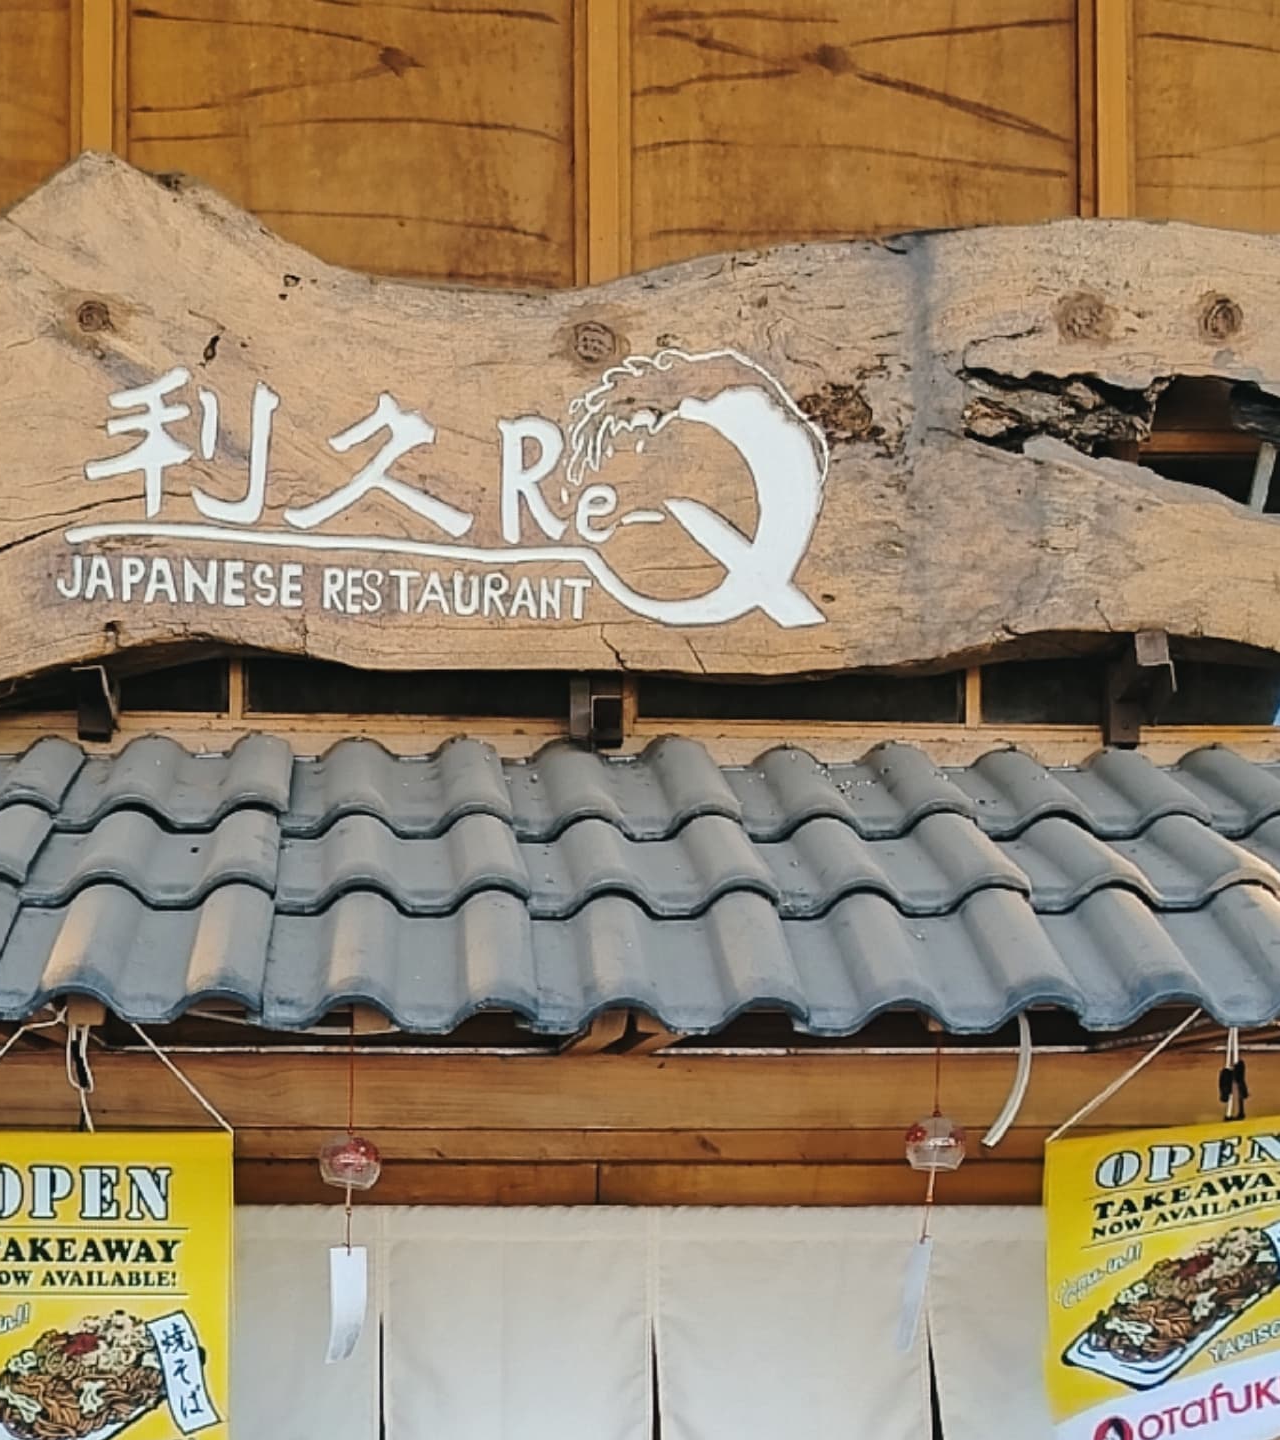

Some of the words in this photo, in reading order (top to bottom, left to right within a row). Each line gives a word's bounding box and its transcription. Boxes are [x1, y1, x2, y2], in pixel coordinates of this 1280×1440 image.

[84, 366, 472, 537] 利久
[57, 555, 303, 607] JAPANESE
[322, 569, 593, 621] RESTAURANT
[1092, 1216, 1143, 1239] NOW
[41, 1270, 177, 1287] AVAILABLE!
[160, 1323, 204, 1418] 焼そば
